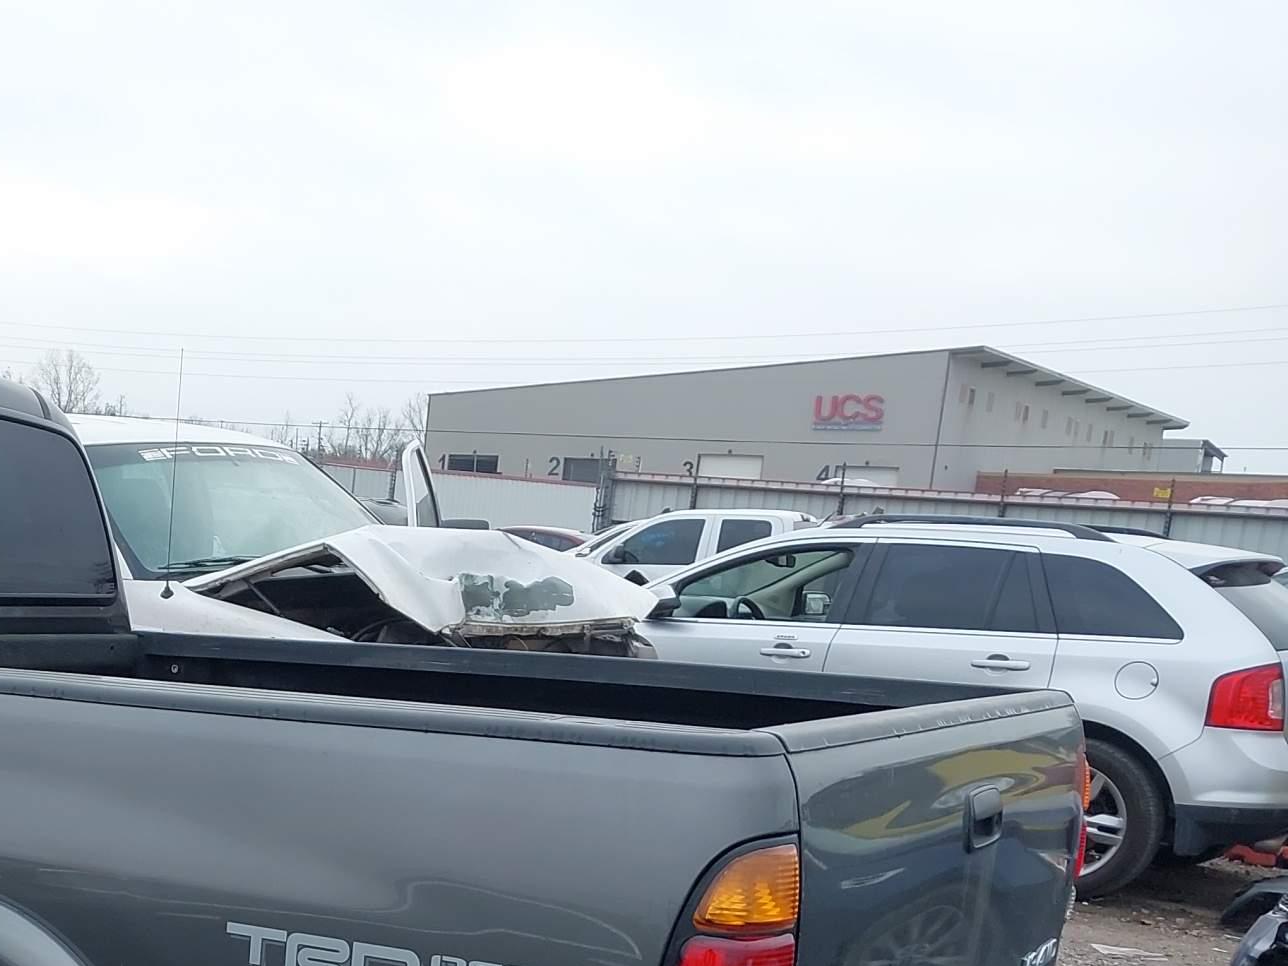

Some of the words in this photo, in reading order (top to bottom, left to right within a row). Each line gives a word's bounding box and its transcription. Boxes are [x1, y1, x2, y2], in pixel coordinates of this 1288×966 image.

[813, 394, 885, 422] UCS
[159, 446, 284, 462] FORD
[438, 453, 447, 471] 1
[547, 456, 561, 476] 2
[682, 460, 694, 476] 3
[816, 464, 831, 481] 4
